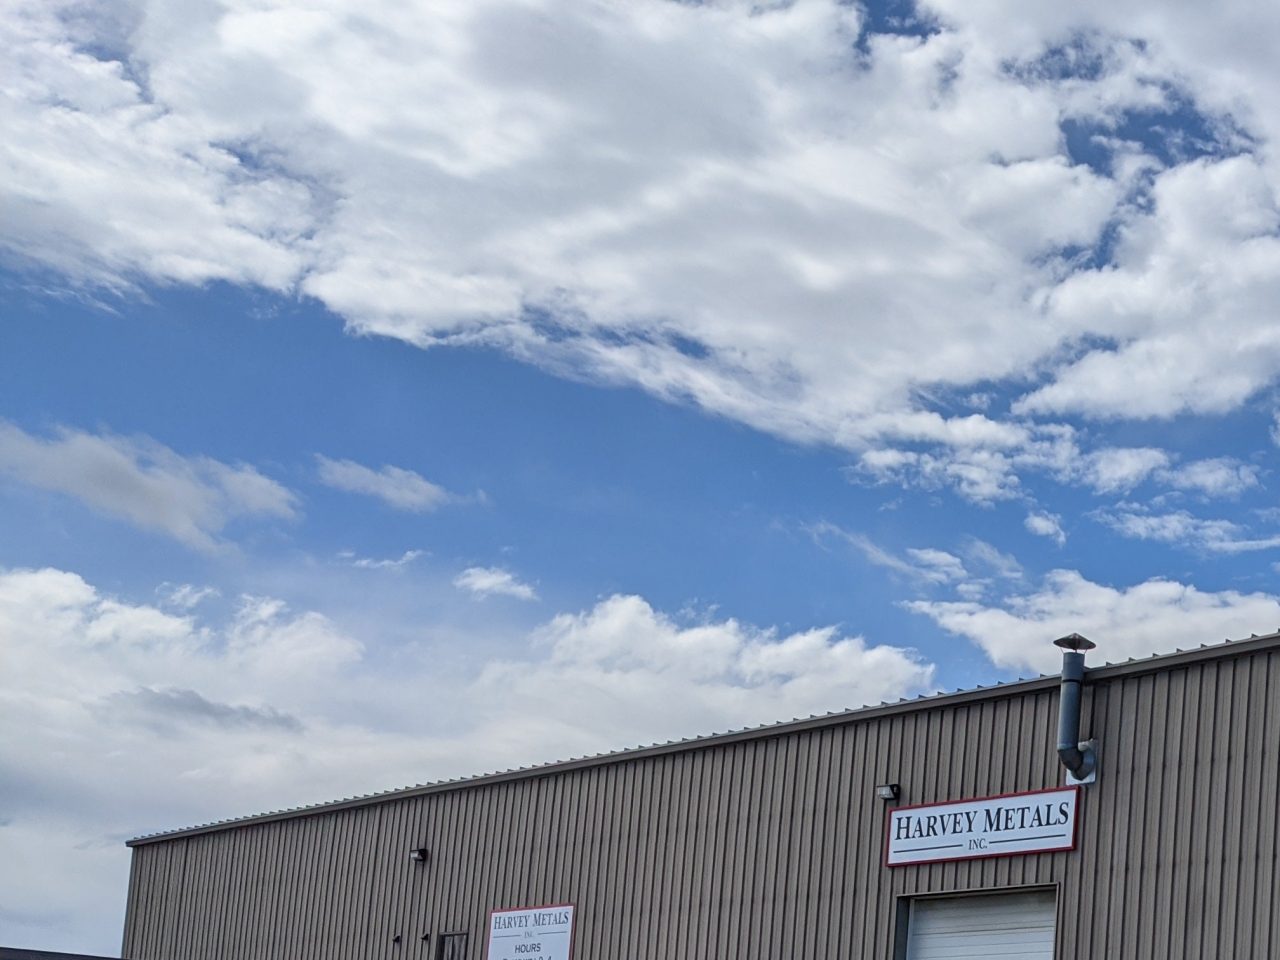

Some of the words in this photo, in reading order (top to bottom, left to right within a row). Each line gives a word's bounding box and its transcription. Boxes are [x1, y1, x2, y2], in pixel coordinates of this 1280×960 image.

[894, 811, 978, 841] HARVEY
[983, 802, 1070, 833] METALS
[968, 838, 988, 851] INC.
[494, 915, 530, 930] HARVEY
[532, 911, 569, 927] METALS
[514, 943, 541, 953] HOURS
